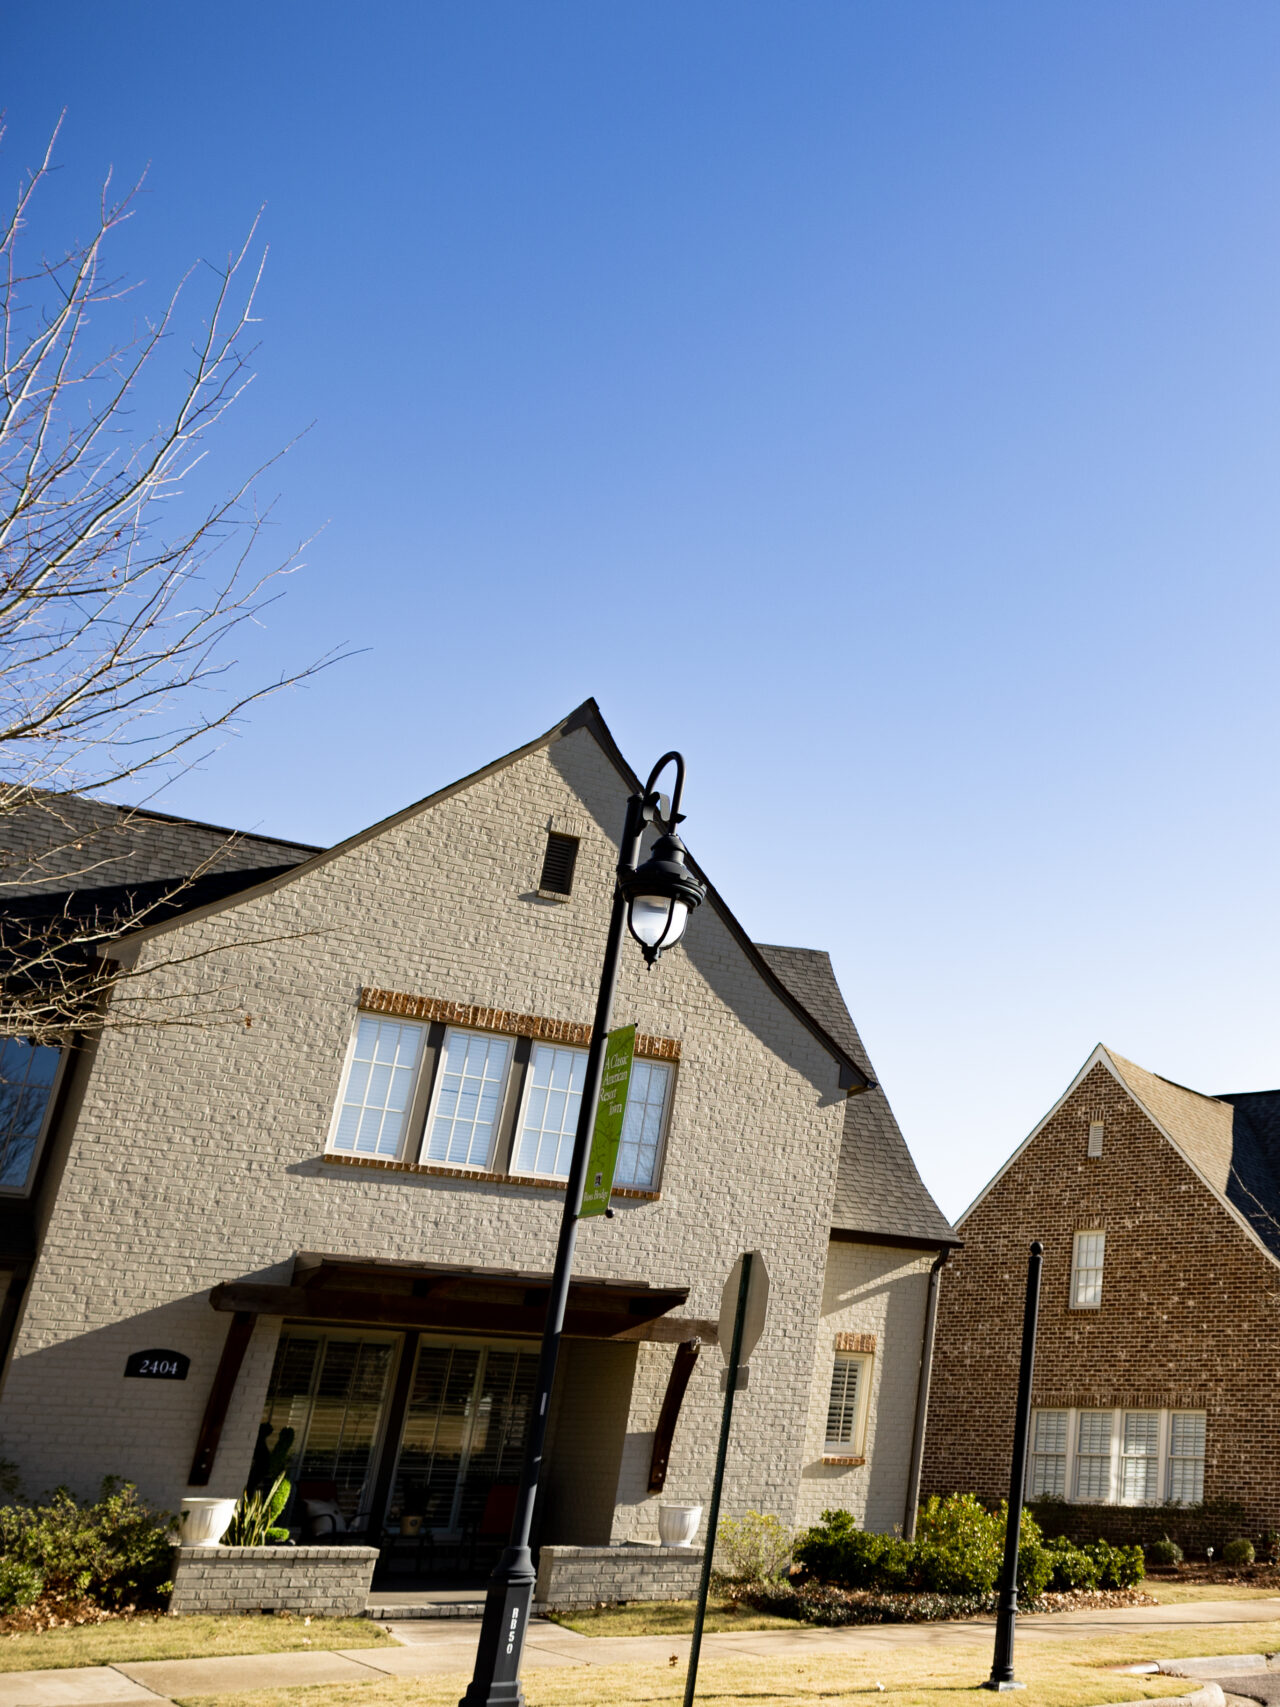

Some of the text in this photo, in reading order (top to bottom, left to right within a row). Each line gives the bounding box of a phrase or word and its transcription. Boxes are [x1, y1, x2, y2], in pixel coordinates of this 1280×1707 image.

[610, 1051, 629, 1069] Classic
[602, 1068, 628, 1087] American
[600, 1087, 617, 1102] Resort
[608, 1101, 622, 1116] Town
[139, 1359, 178, 1375] 2404
